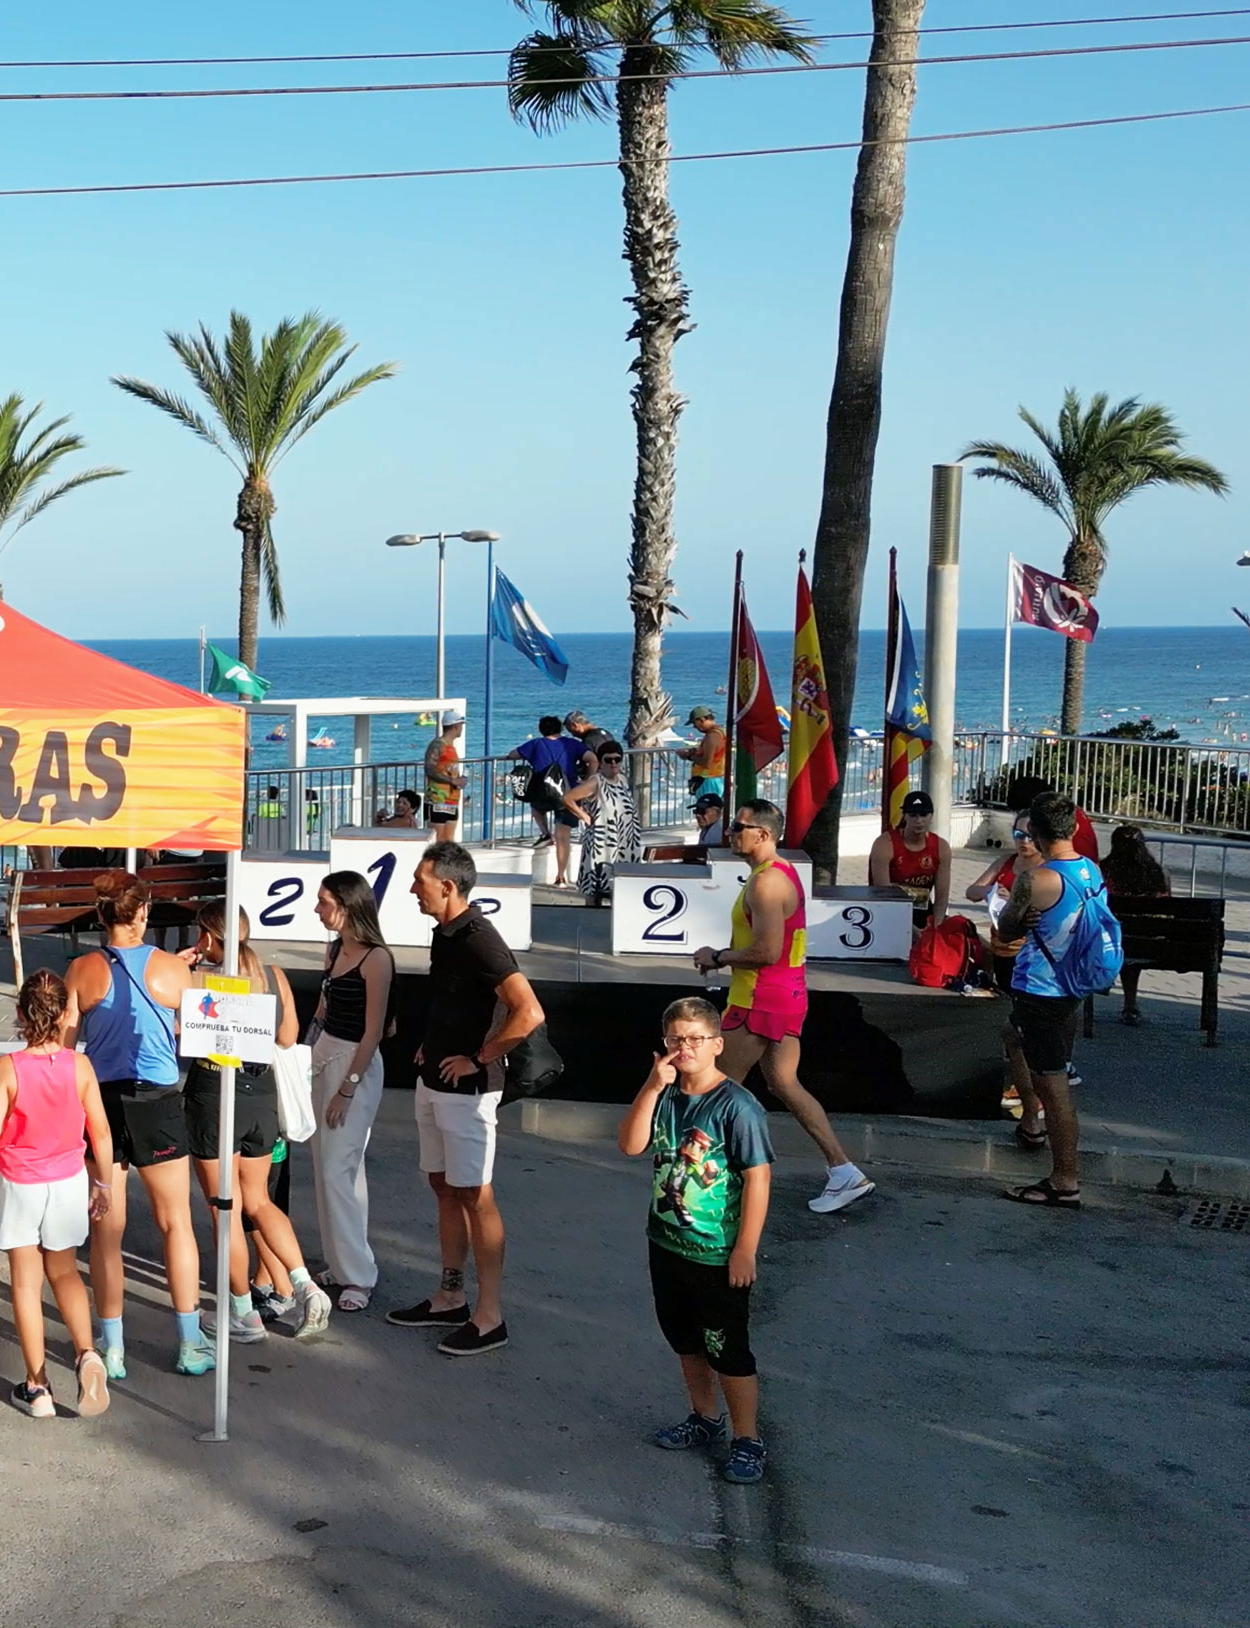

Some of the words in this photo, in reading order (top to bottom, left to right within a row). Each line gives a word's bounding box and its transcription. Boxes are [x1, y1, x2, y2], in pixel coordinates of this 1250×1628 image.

[259, 877, 304, 927] 2
[367, 851, 398, 914] 1
[641, 884, 688, 945] 2
[839, 905, 875, 951] 3
[185, 1022, 230, 1032] COMPRUEBA
[232, 1025, 242, 1033] TU
[243, 1027, 273, 1036] DORSAL
